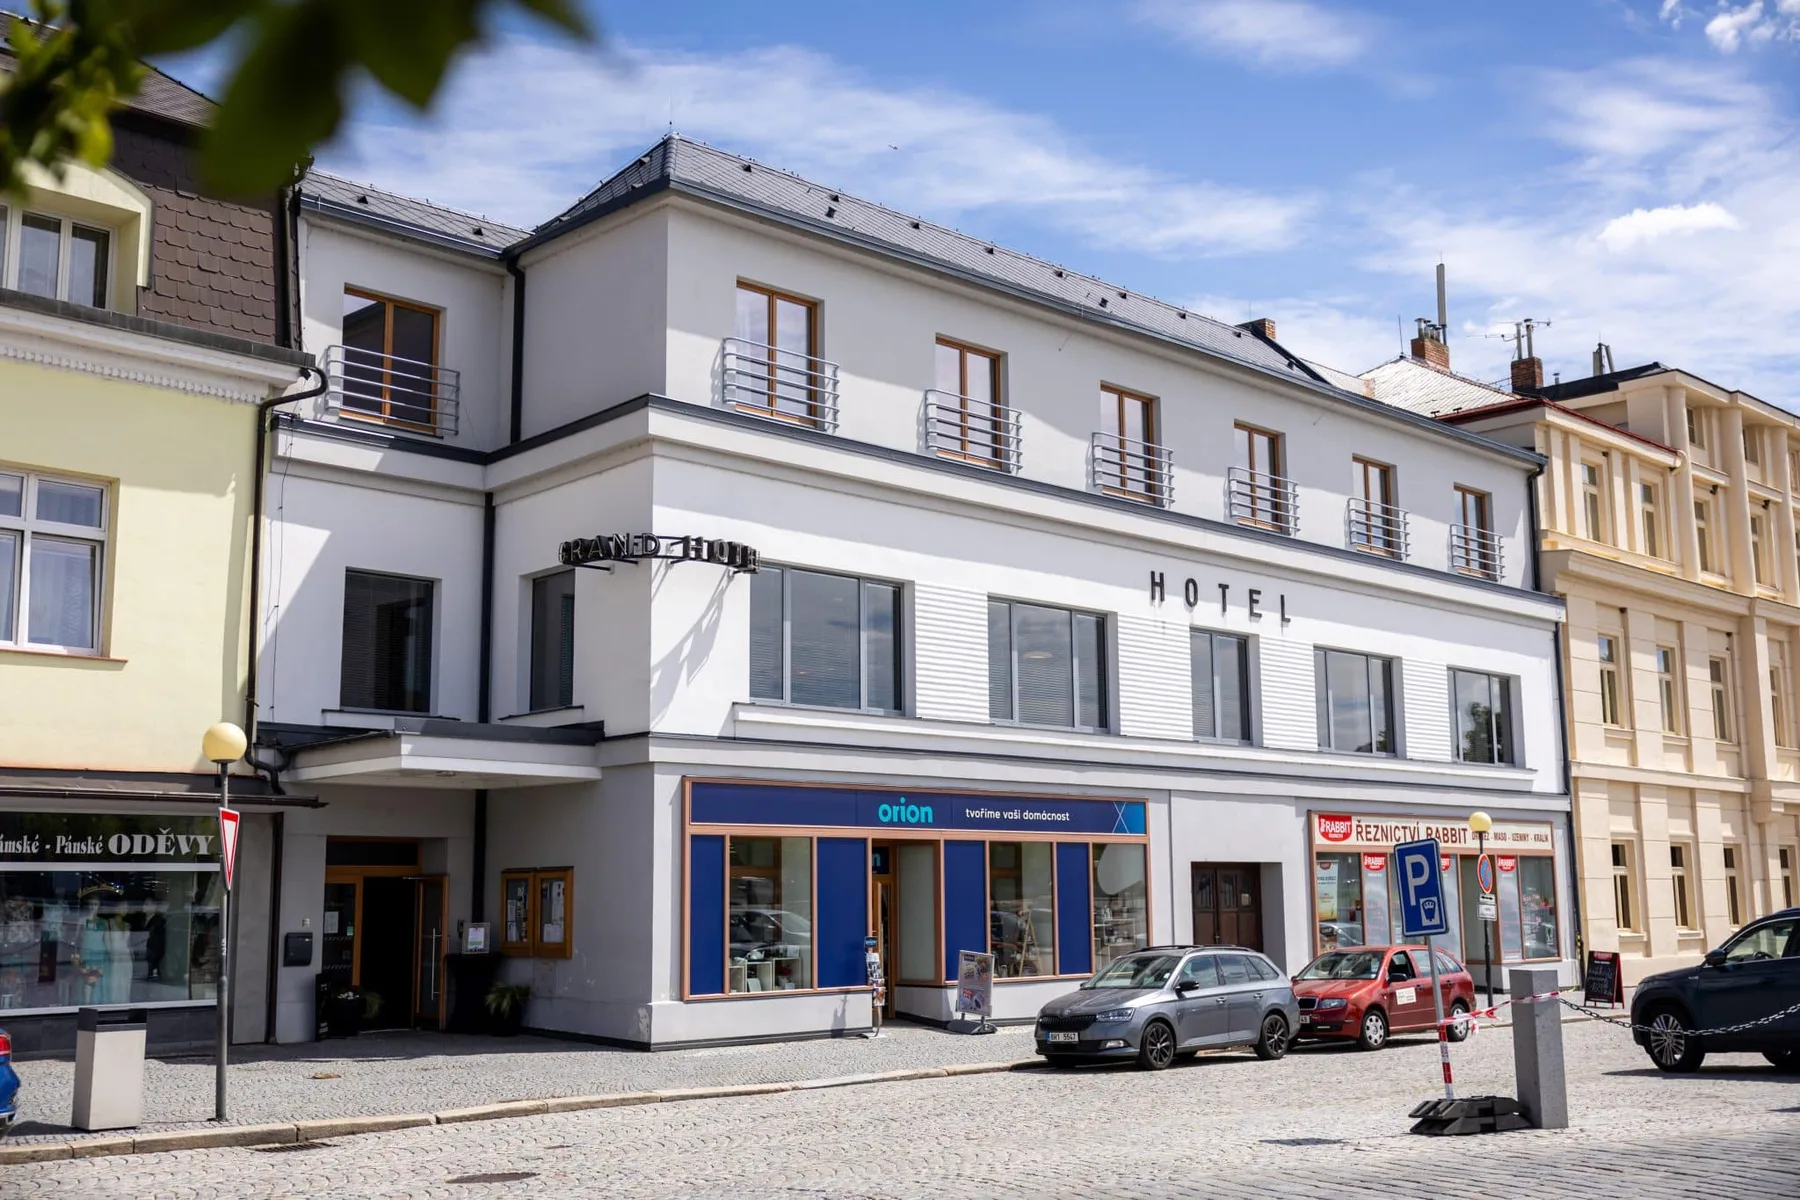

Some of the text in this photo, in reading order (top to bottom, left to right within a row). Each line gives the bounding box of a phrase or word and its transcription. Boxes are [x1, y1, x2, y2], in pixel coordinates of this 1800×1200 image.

[558, 533, 660, 565] GRAND
[1150, 571, 1291, 623] HOTEL
[878, 797, 933, 823] orion
[965, 808, 1070, 821] tvoříme vaši domácnost
[1325, 821, 1351, 834] RABBIT
[1355, 818, 1468, 844] ŘEZNICTVÍ RABBIT
[55, 834, 103, 854] Pánské
[108, 827, 215, 856] ODĚVY
[1404, 854, 1430, 906] P
